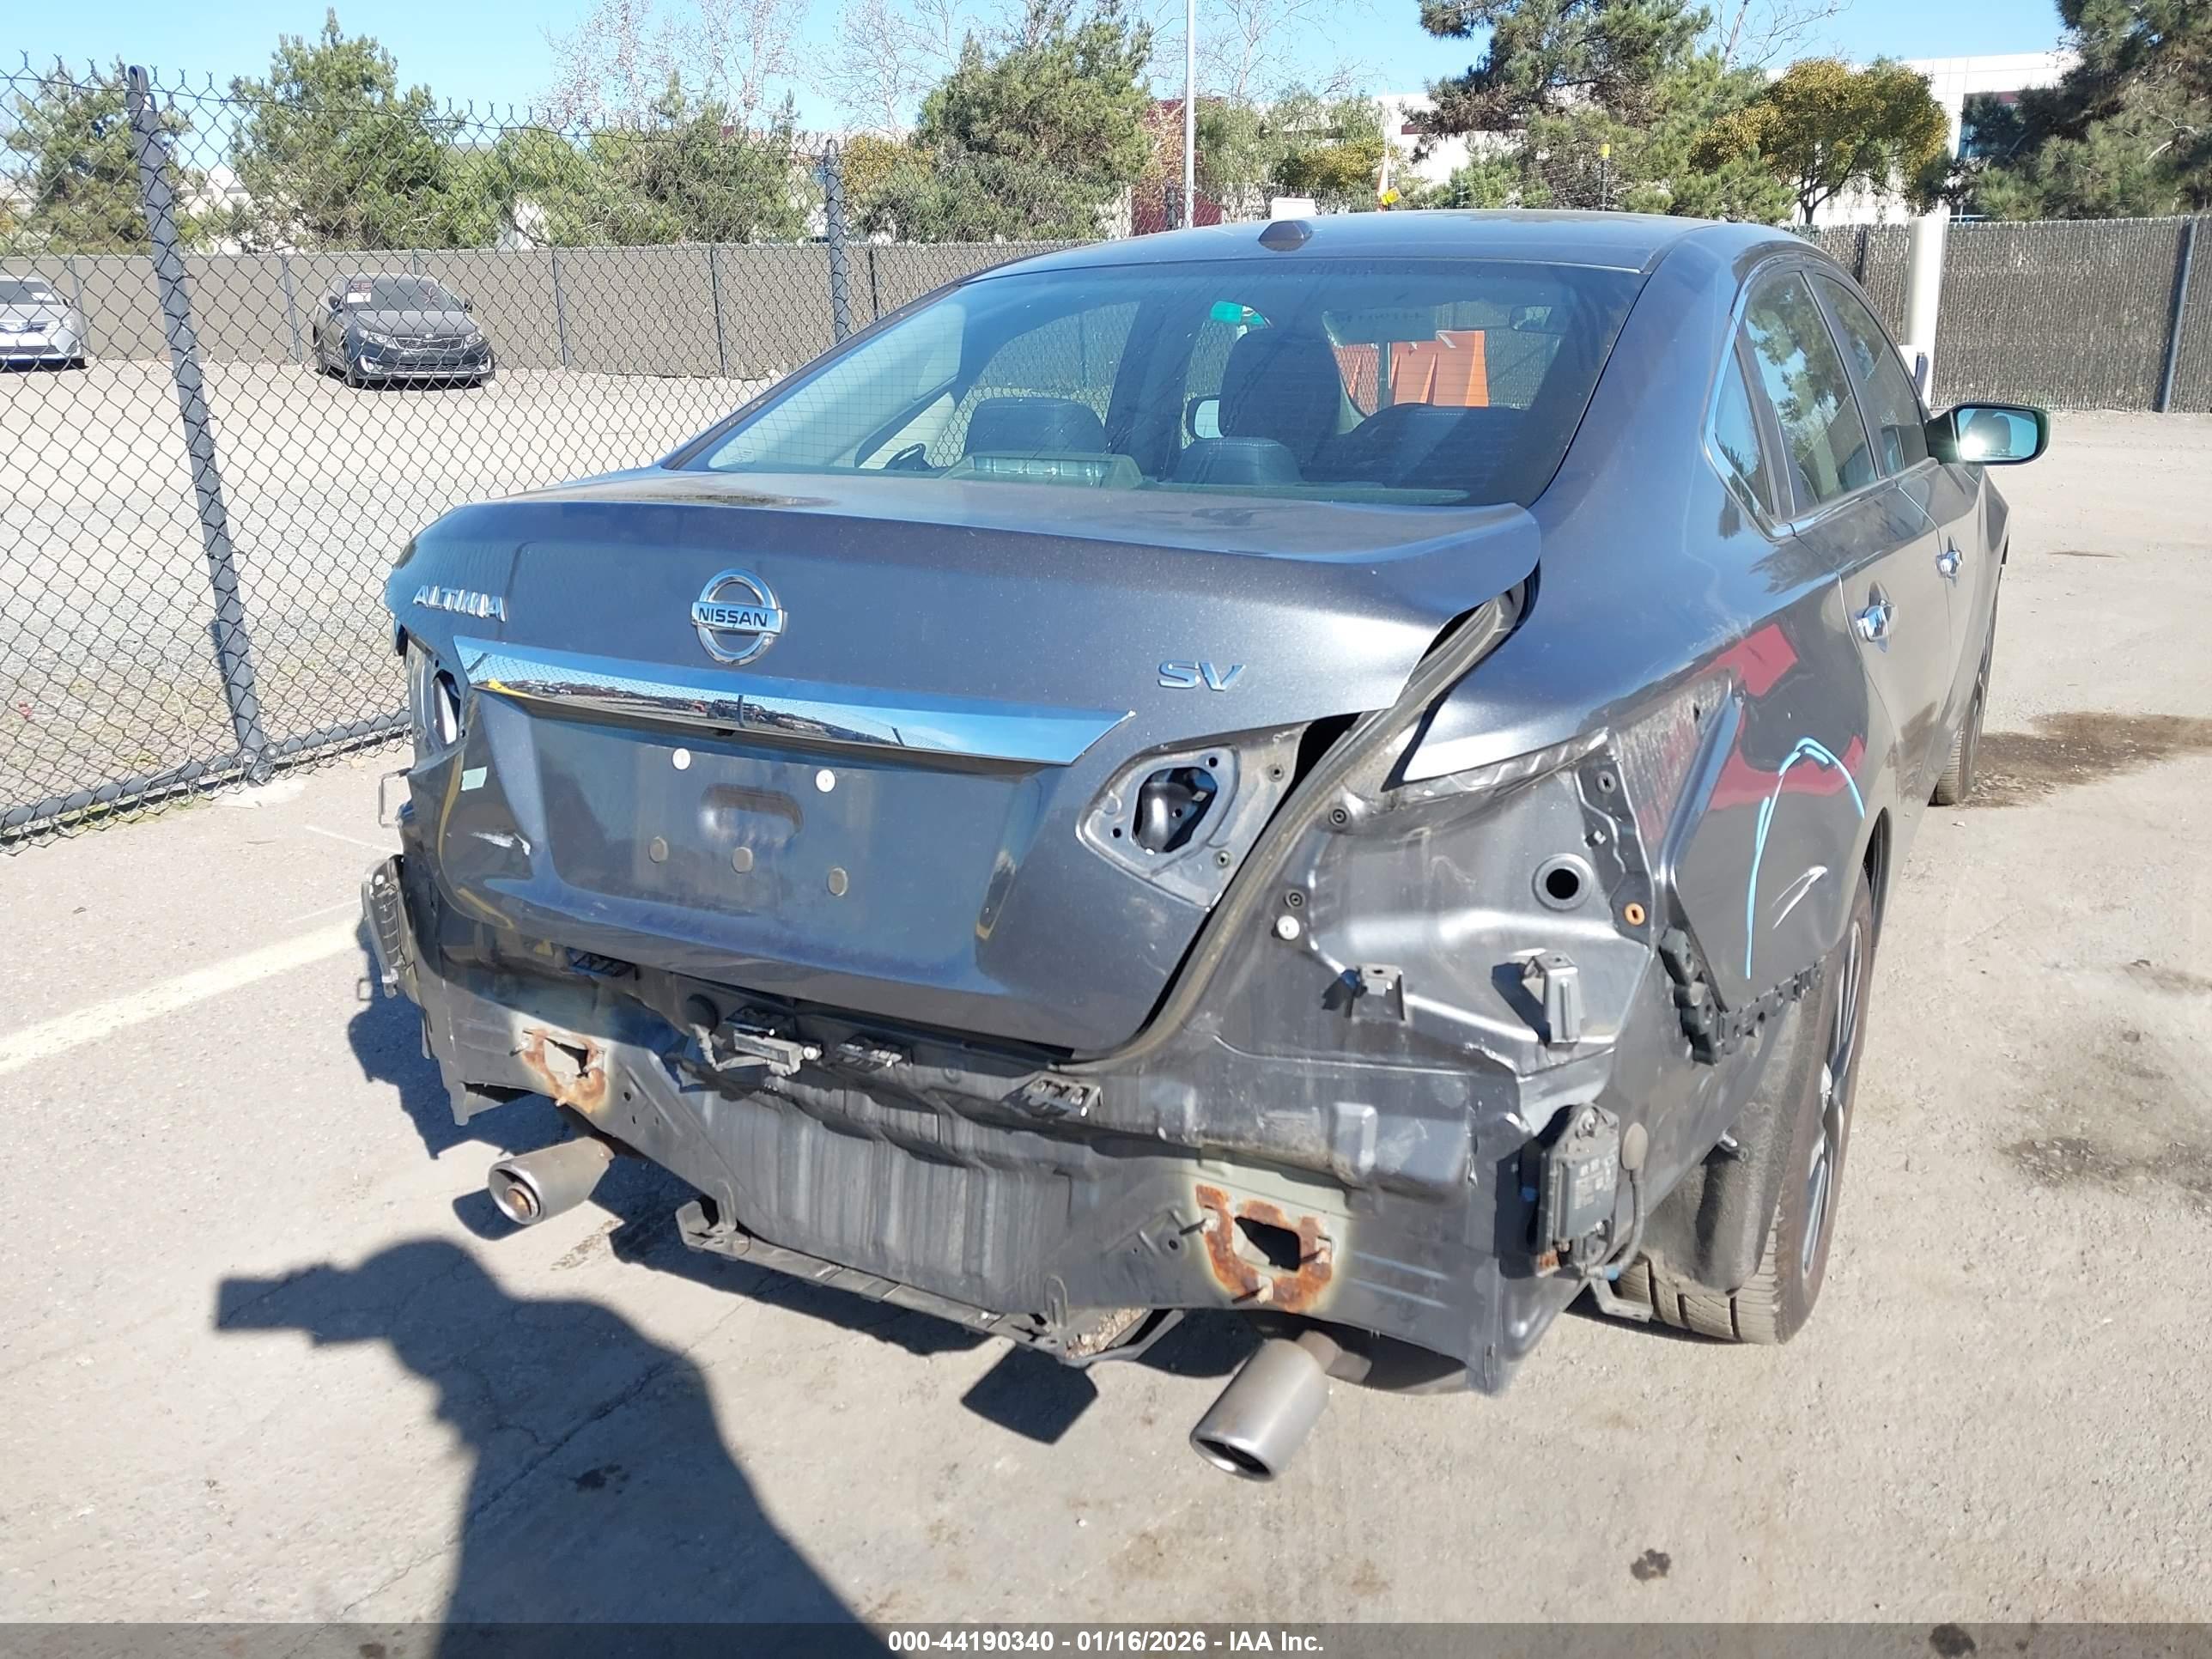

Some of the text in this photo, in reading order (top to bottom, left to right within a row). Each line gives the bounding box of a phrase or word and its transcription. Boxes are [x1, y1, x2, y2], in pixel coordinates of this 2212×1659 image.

[412, 585, 507, 623] ALTIMA
[698, 607, 769, 628] NISSAN
[1157, 659, 1246, 692] SV
